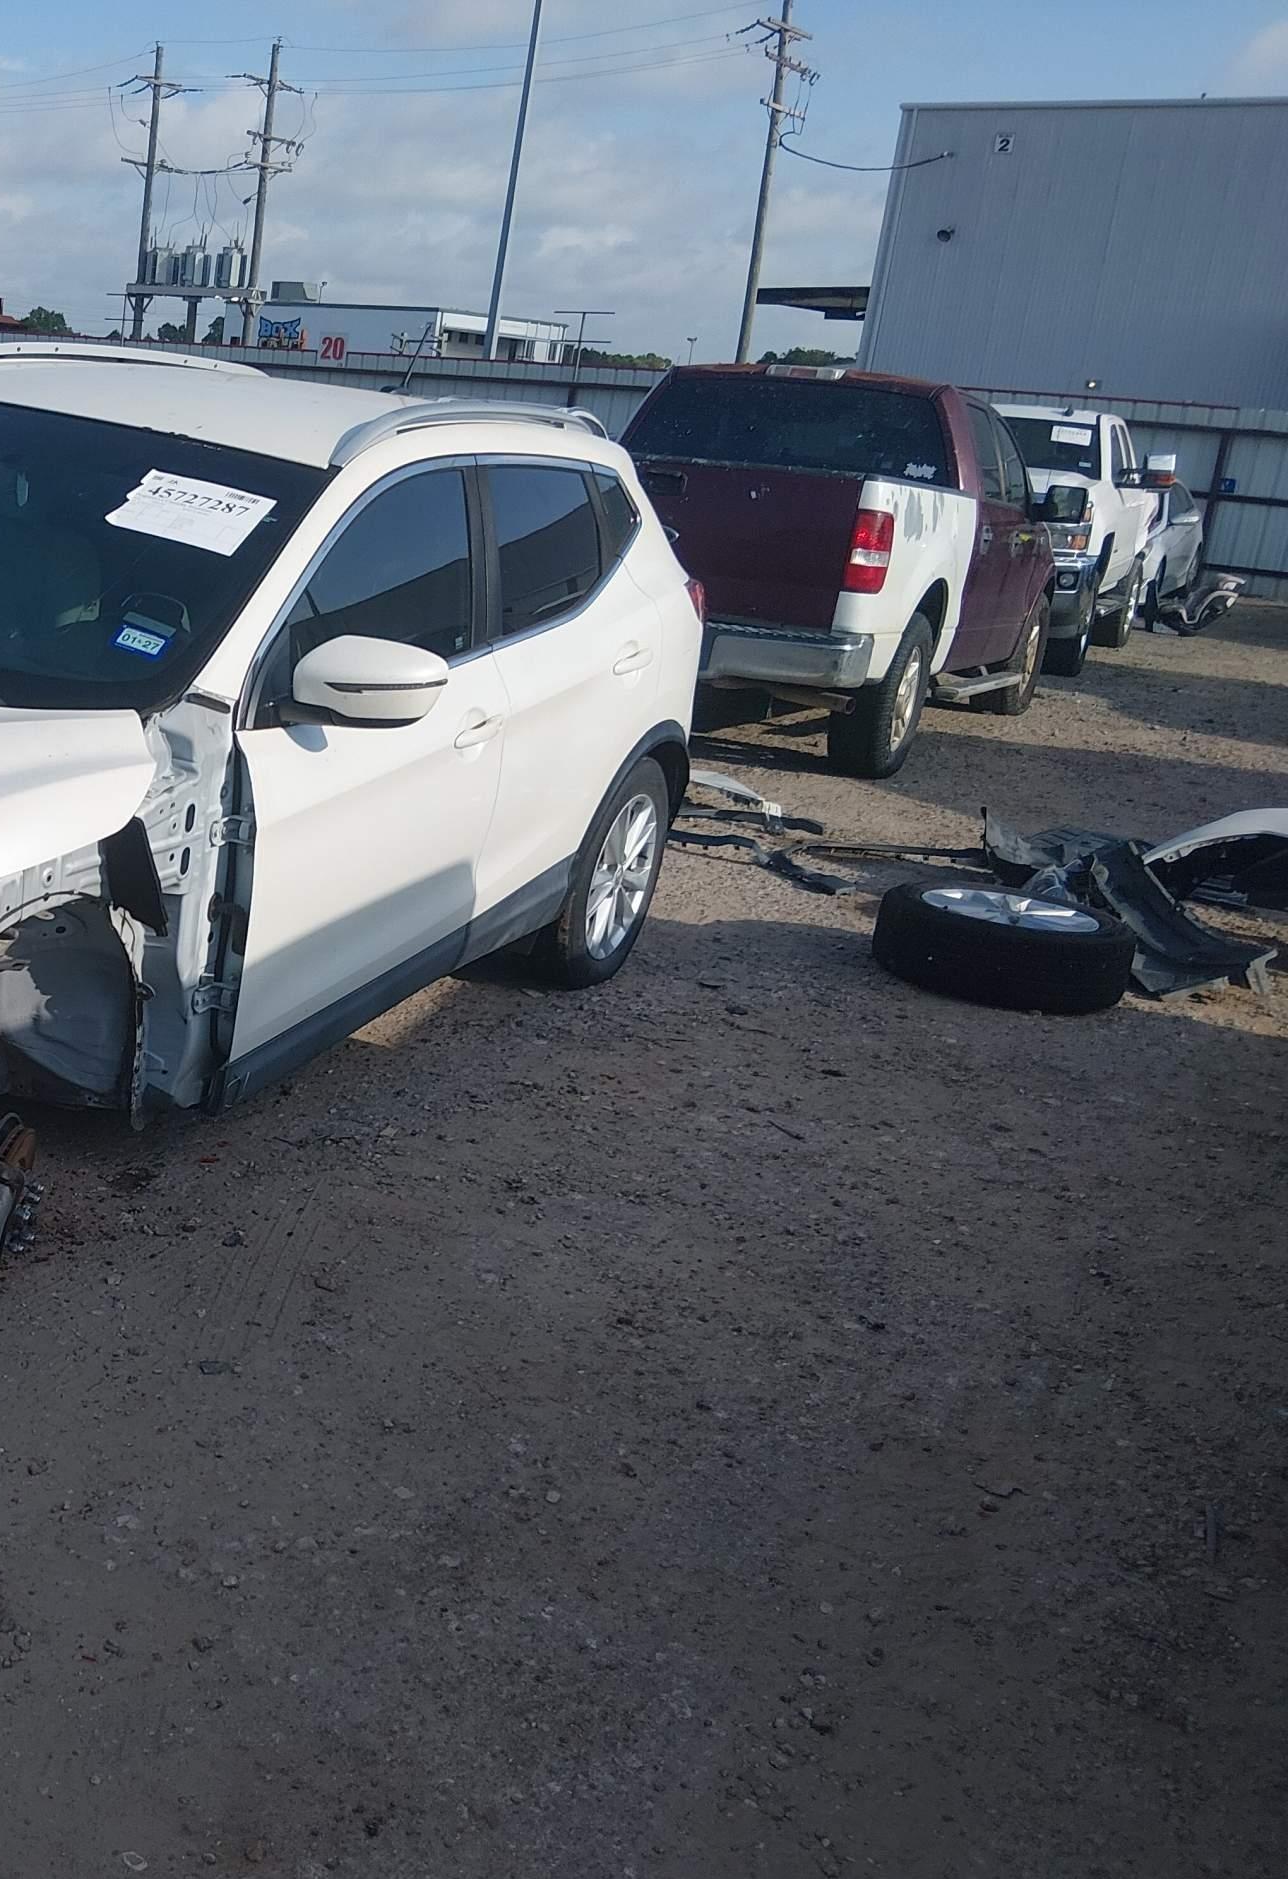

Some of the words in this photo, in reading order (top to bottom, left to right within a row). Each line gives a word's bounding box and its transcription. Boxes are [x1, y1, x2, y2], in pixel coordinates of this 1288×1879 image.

[998, 138, 1011, 152] 2
[258, 316, 301, 340] BOX
[320, 336, 345, 360] 20
[147, 486, 250, 517] 45727287
[121, 633, 138, 645] 01
[141, 640, 160, 651] 27
